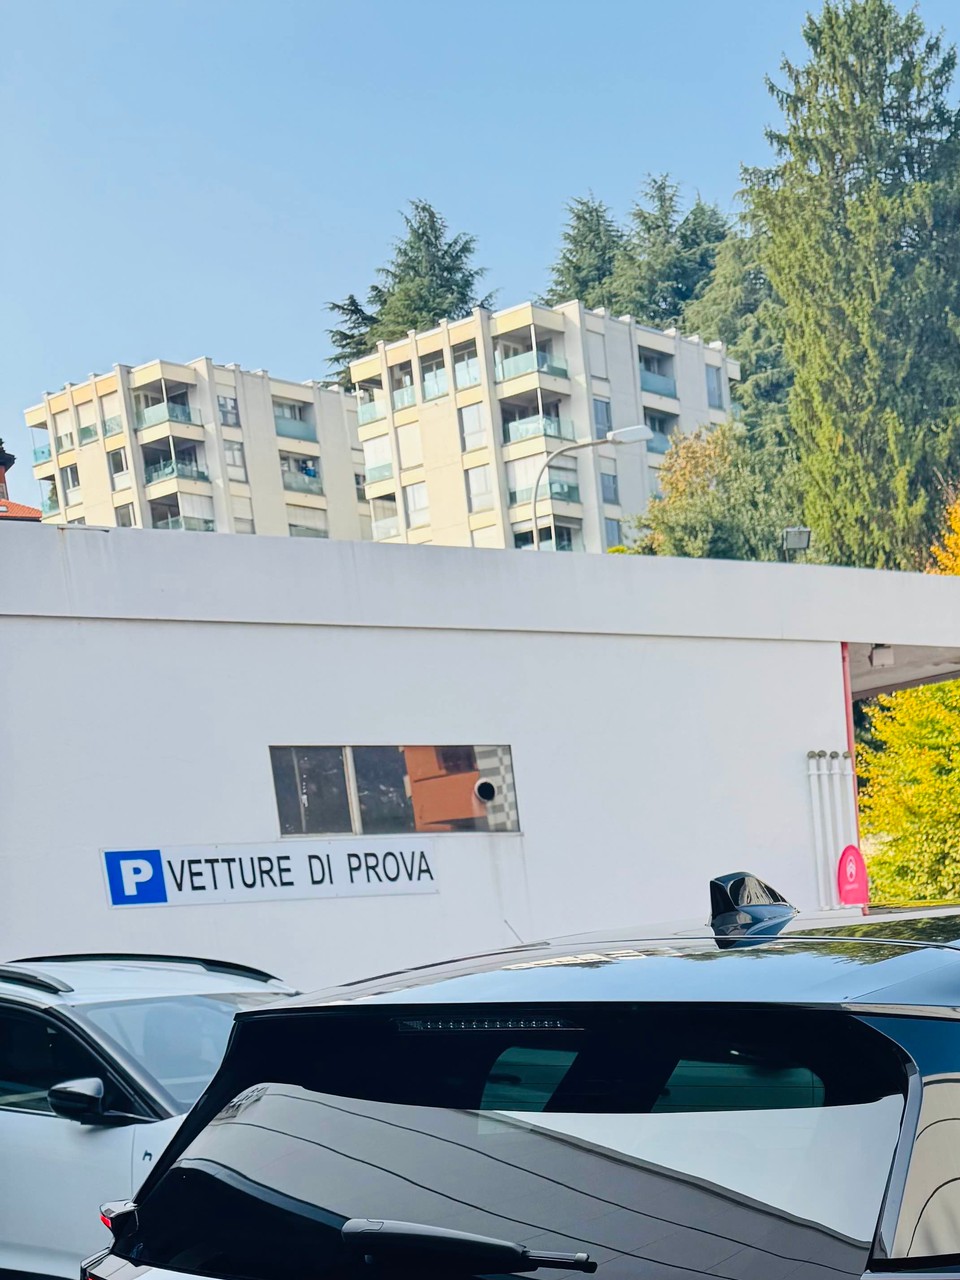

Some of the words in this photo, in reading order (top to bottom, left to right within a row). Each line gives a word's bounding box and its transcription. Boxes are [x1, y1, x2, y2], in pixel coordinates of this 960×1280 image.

[119, 858, 154, 897] P
[167, 855, 294, 892] VETTURE
[308, 853, 334, 886] DI
[347, 850, 434, 884] PROVA
